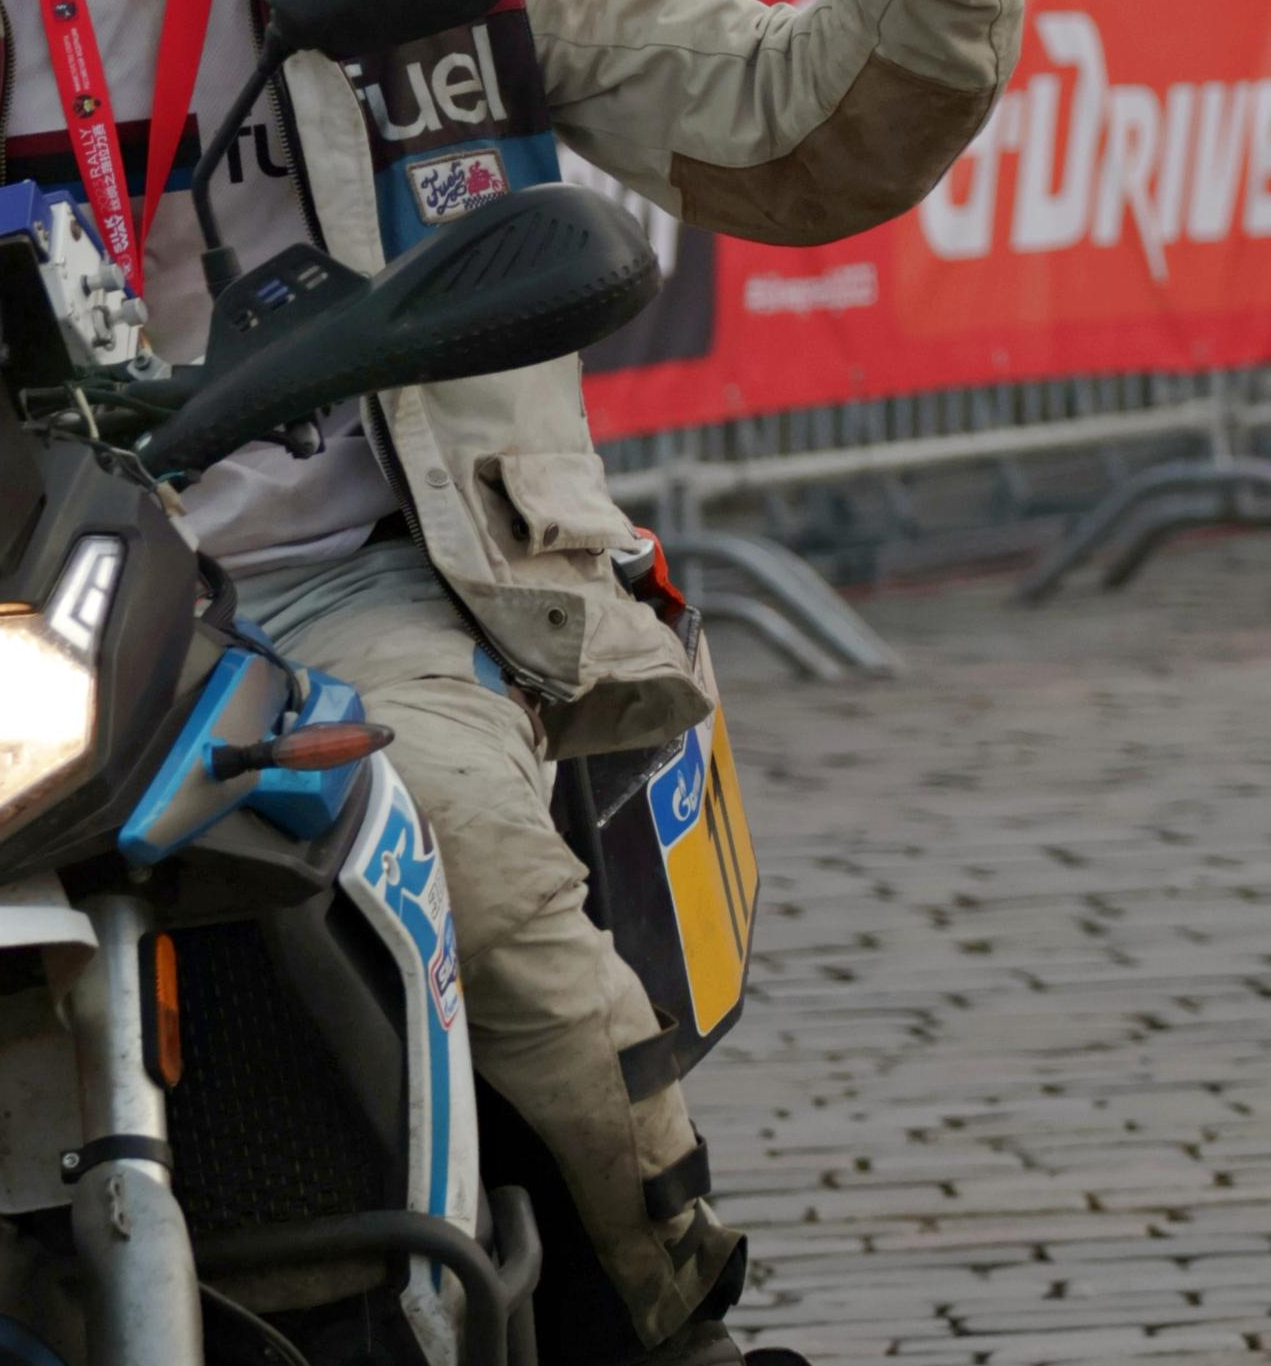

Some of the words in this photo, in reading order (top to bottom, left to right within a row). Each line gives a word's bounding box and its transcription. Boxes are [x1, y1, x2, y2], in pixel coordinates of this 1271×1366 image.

[80, 129, 102, 179] RALLY
[104, 215, 123, 255] SILK
[113, 214, 130, 252] WAY
